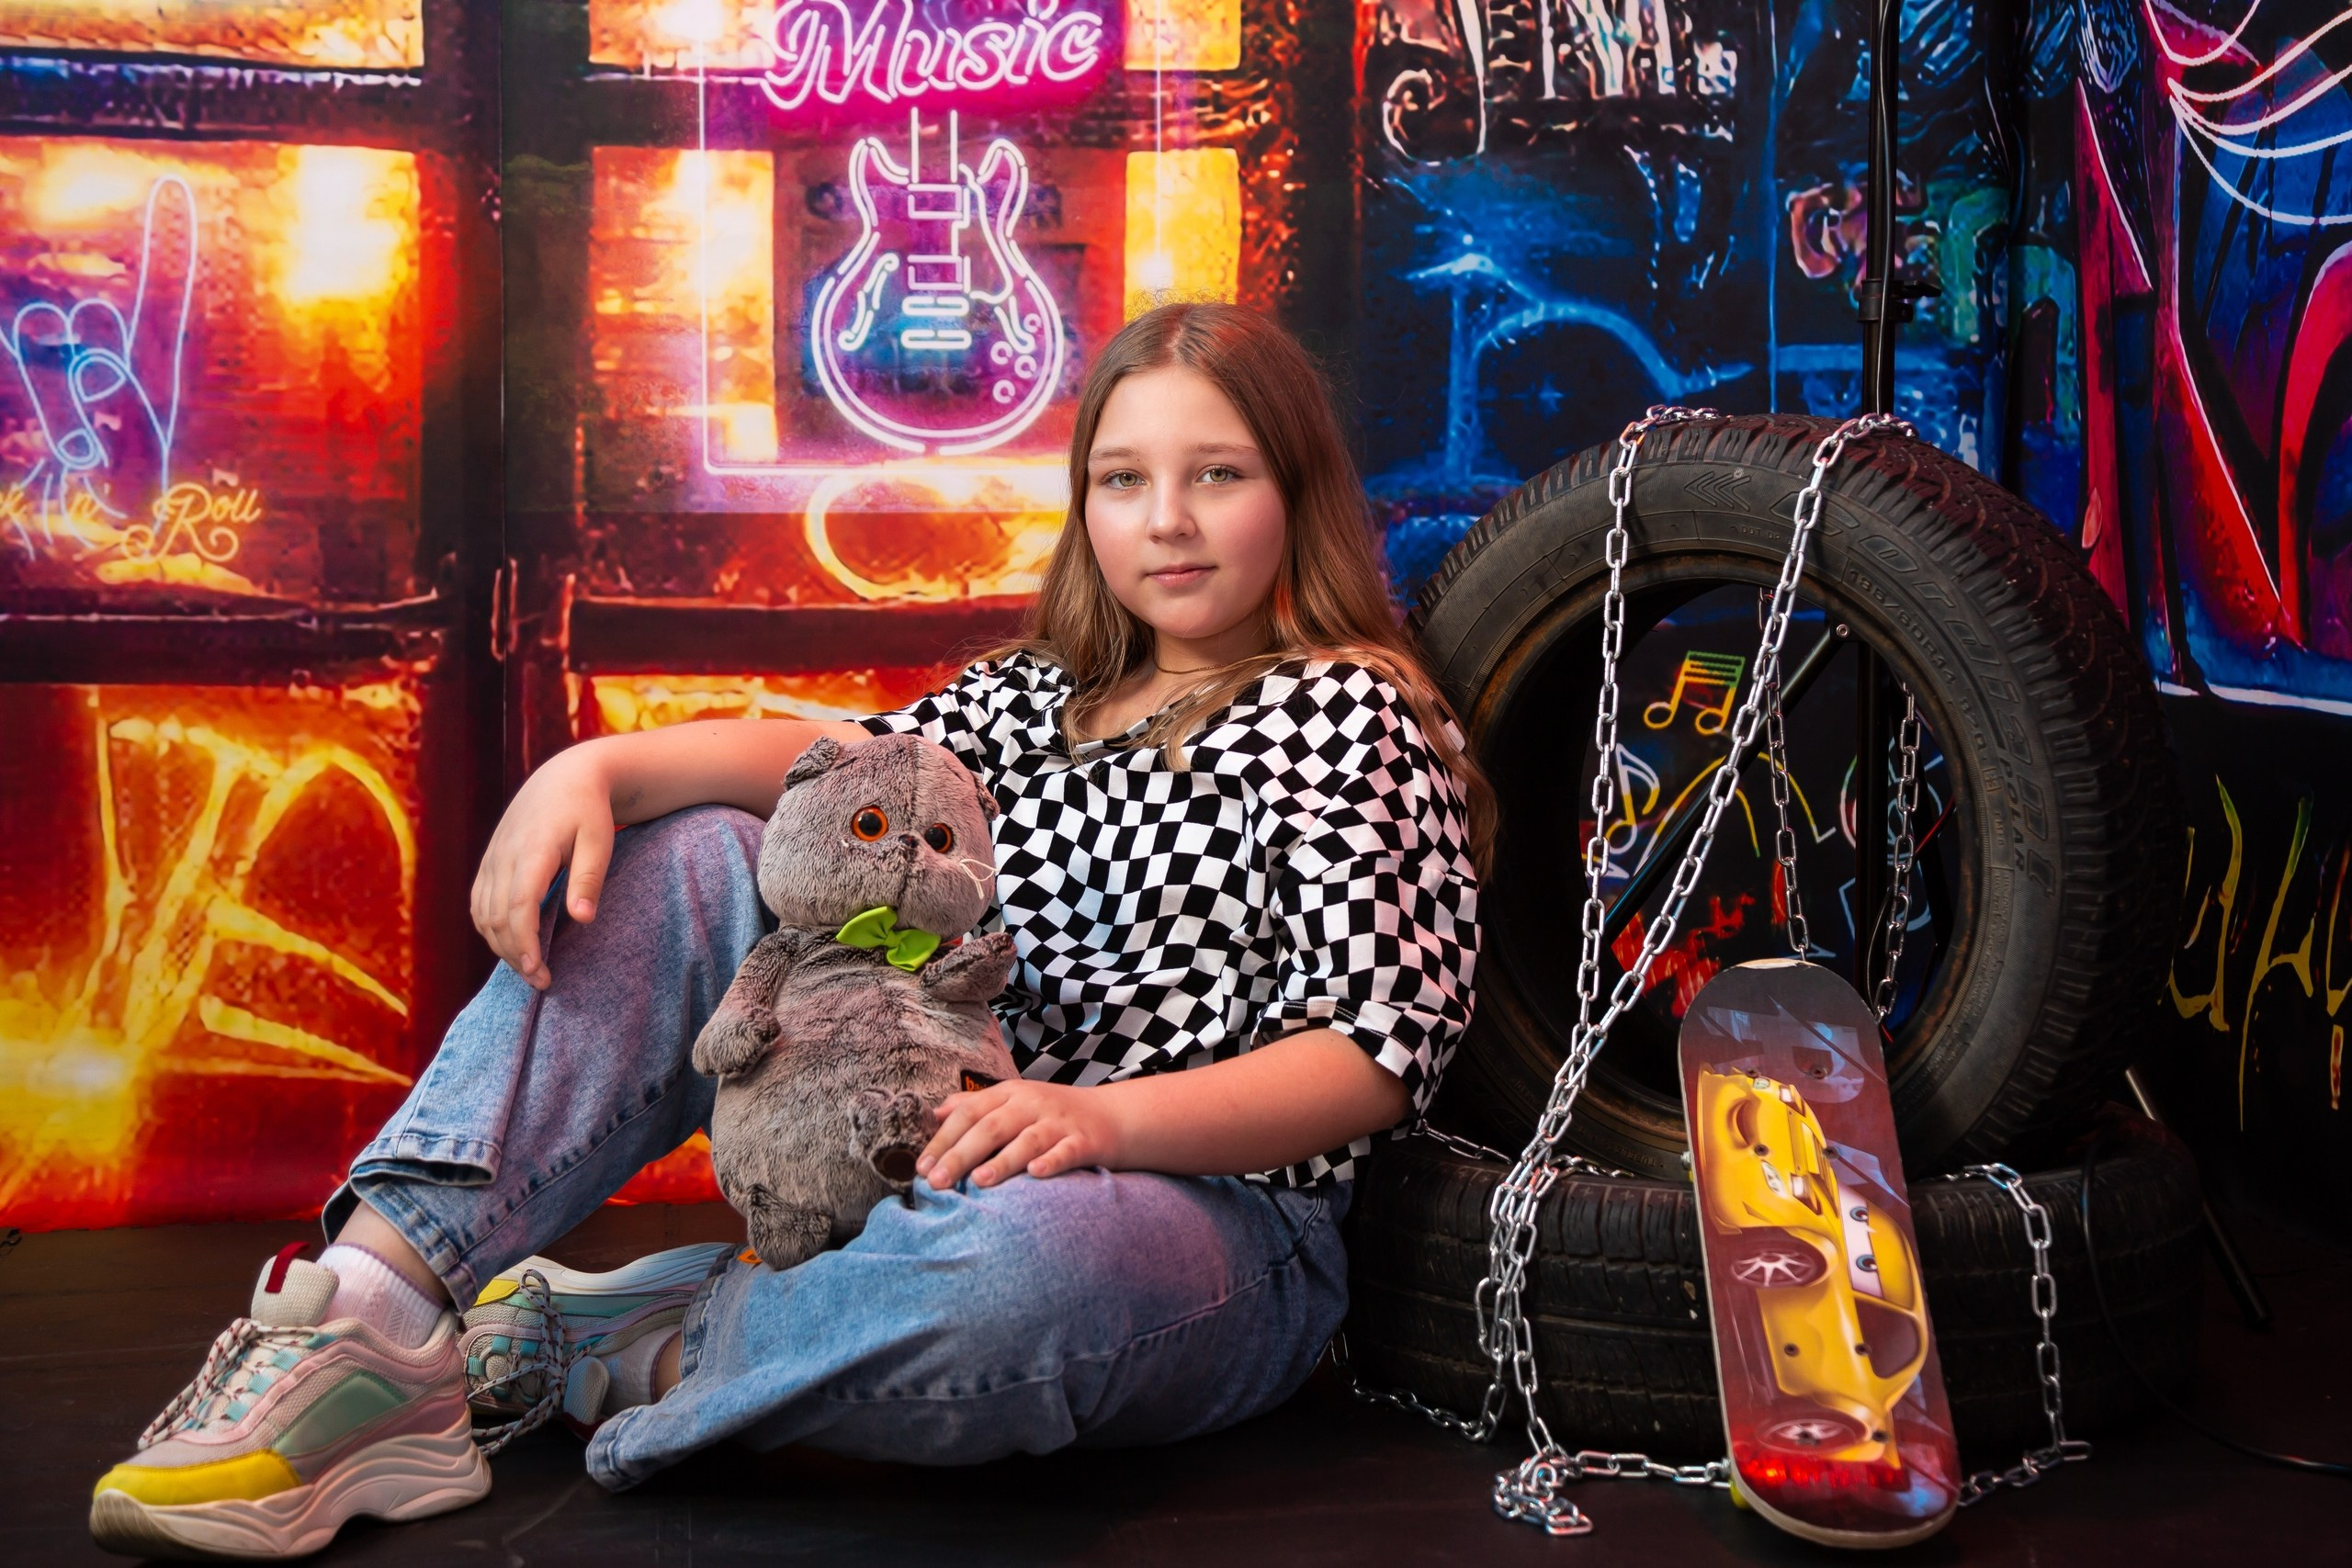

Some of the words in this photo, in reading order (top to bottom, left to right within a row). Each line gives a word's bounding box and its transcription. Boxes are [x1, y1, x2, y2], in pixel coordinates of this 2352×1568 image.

[761, 0, 1102, 110] Music
[121, 481, 263, 564] Roll
[1997, 756, 2025, 872] POLAR
[1600, 1137, 1657, 1168] TUBELESS
